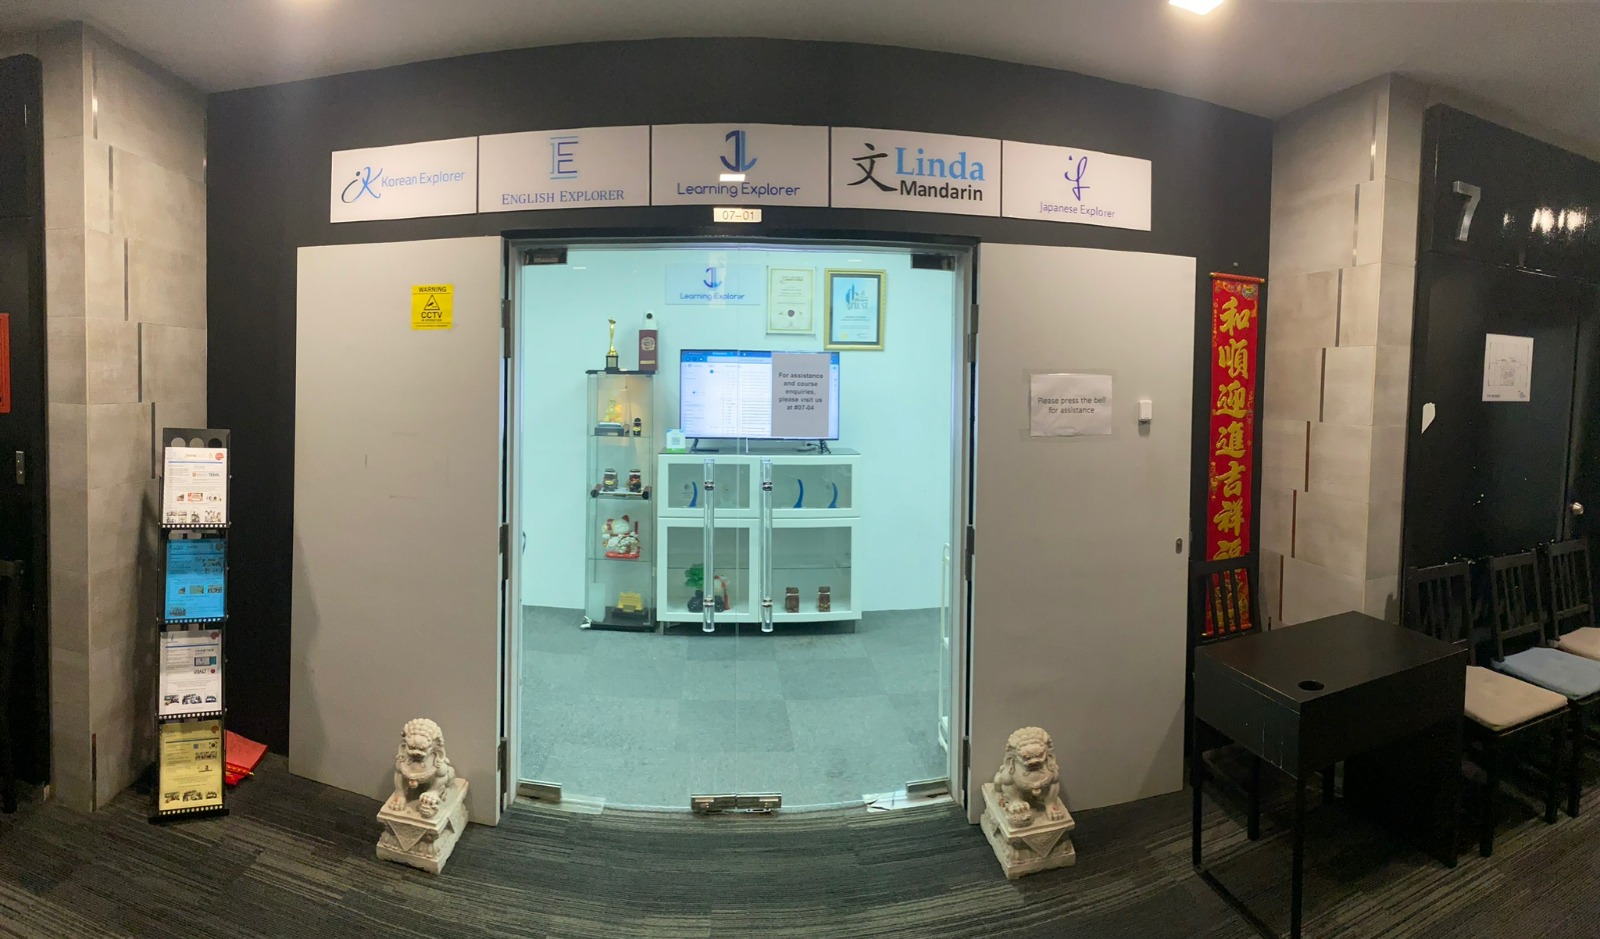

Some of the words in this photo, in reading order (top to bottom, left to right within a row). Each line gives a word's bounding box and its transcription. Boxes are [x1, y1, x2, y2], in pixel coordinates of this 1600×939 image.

[846, 142, 898, 192] 文
[895, 146, 985, 181] Linda
[381, 176, 418, 187] Korean
[419, 171, 466, 186] Explorer
[501, 192, 555, 205] ENGLISH
[559, 189, 625, 203] EXPLORER
[677, 182, 738, 198] Learning
[741, 181, 801, 198] Explorer
[900, 180, 983, 201] Mandarin
[722, 210, 755, 220] 07-01
[1039, 201, 1078, 214] Japanese
[1080, 204, 1115, 217] Explorer
[1453, 180, 1481, 242] 7
[680, 292, 713, 301] Learning
[713, 292, 746, 301] Explorer
[420, 311, 443, 319] CCTV
[778, 371, 789, 379] For
[1037, 396, 1059, 405] Please
[1060, 397, 1080, 405] press
[1081, 396, 1093, 404] the
[1094, 396, 1107, 404] bell
[1048, 406, 1059, 414] for
[1060, 406, 1095, 414] assistance
